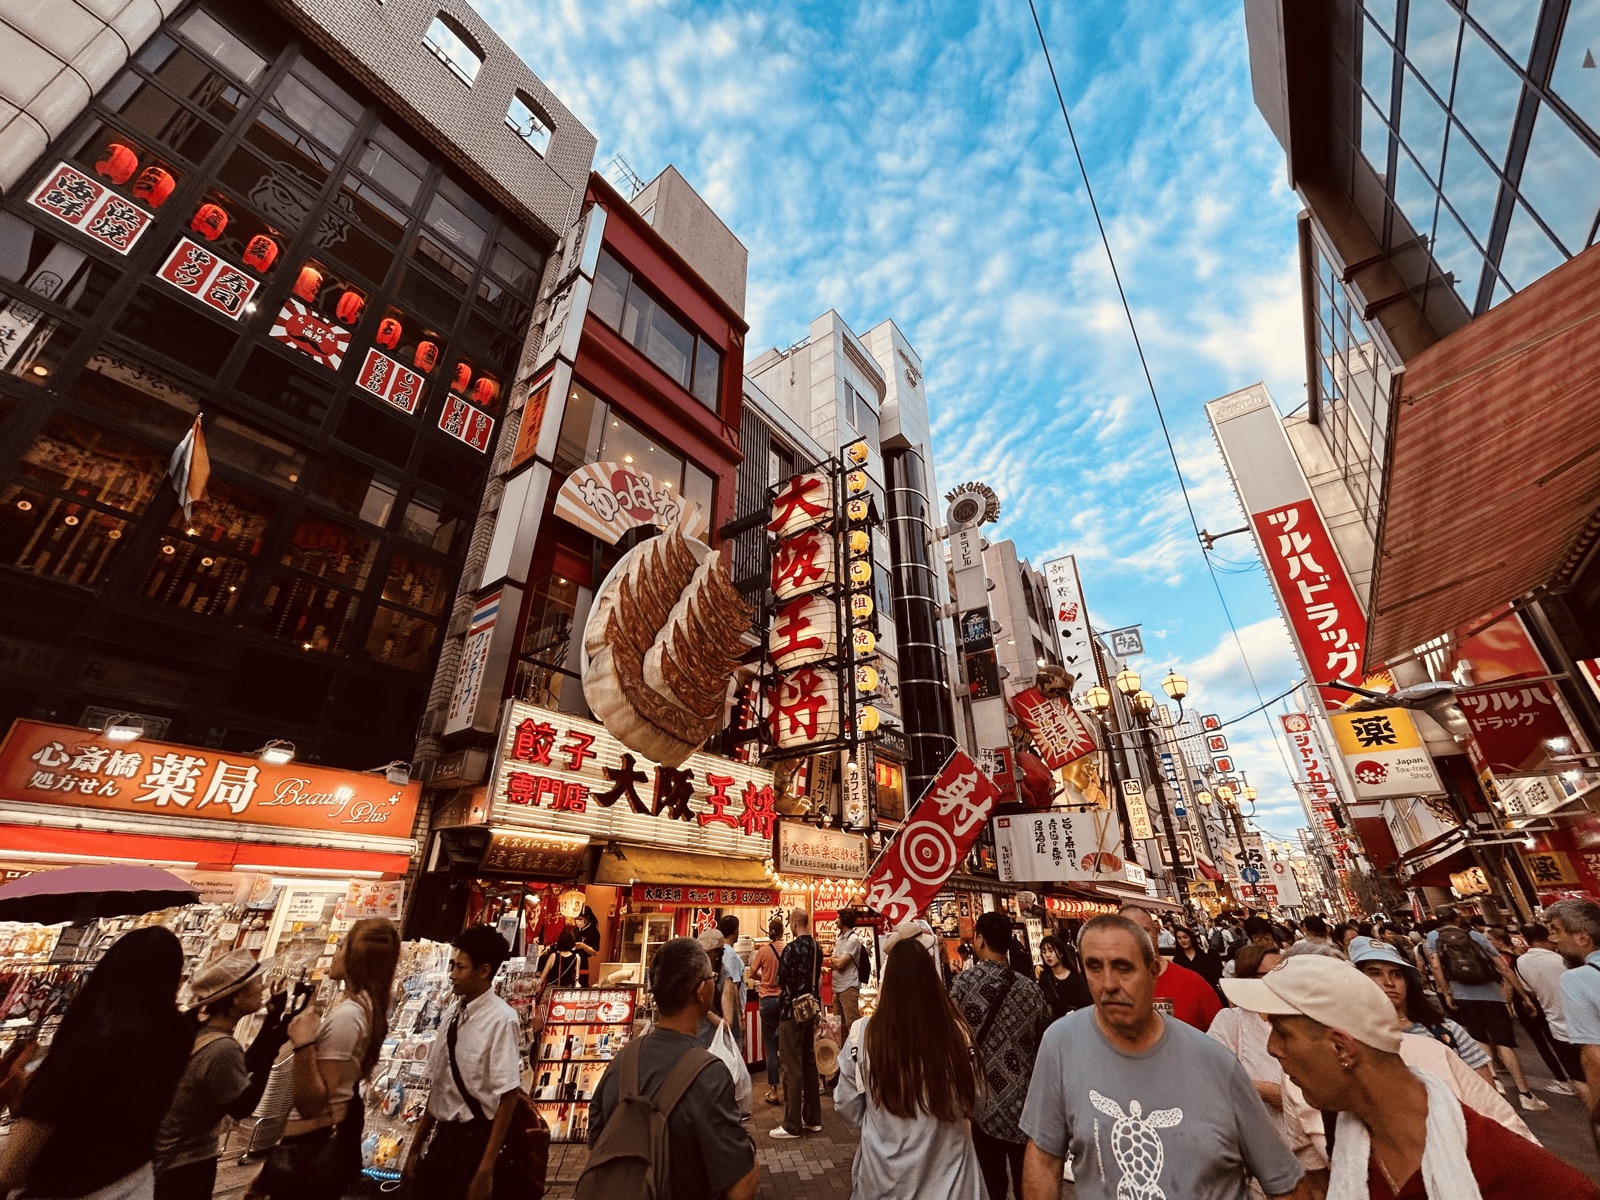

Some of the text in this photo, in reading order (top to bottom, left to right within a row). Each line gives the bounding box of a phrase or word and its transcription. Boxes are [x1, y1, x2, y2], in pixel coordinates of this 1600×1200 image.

[41, 173, 97, 218] 海鮮
[90, 201, 141, 248] 浜焼
[174, 247, 211, 287] 串カツ
[209, 272, 250, 312] 寿司
[392, 371, 415, 410] もつ鍋
[443, 398, 467, 437] 日本酒
[469, 413, 488, 447] 生ビール
[762, 474, 830, 746] 大阪王将
[1267, 508, 1361, 679] ツルハドラッグ
[1460, 687, 1552, 714] ツルハ
[1350, 715, 1398, 748] 薬
[1472, 711, 1540, 732] ドラッグ
[31, 741, 142, 778] 心斎橋
[511, 717, 598, 772] 餃子
[31, 770, 120, 797] 処方せん
[133, 752, 260, 814] 薬局
[849, 770, 858, 801] カフェ
[1396, 765, 1430, 774] Tax-free
[1410, 771, 1433, 780] Shop
[258, 777, 354, 818] Beauty
[503, 771, 590, 814] 専門店
[591, 751, 779, 841] 大阪王将
[340, 800, 391, 825] Plus
[1034, 819, 1046, 854] 居酒屋
[1237, 862, 1267, 871] KRA
[1527, 855, 1563, 882] 薬
[644, 886, 682, 901] 大阪王将
[741, 892, 771, 904] GYOZA
